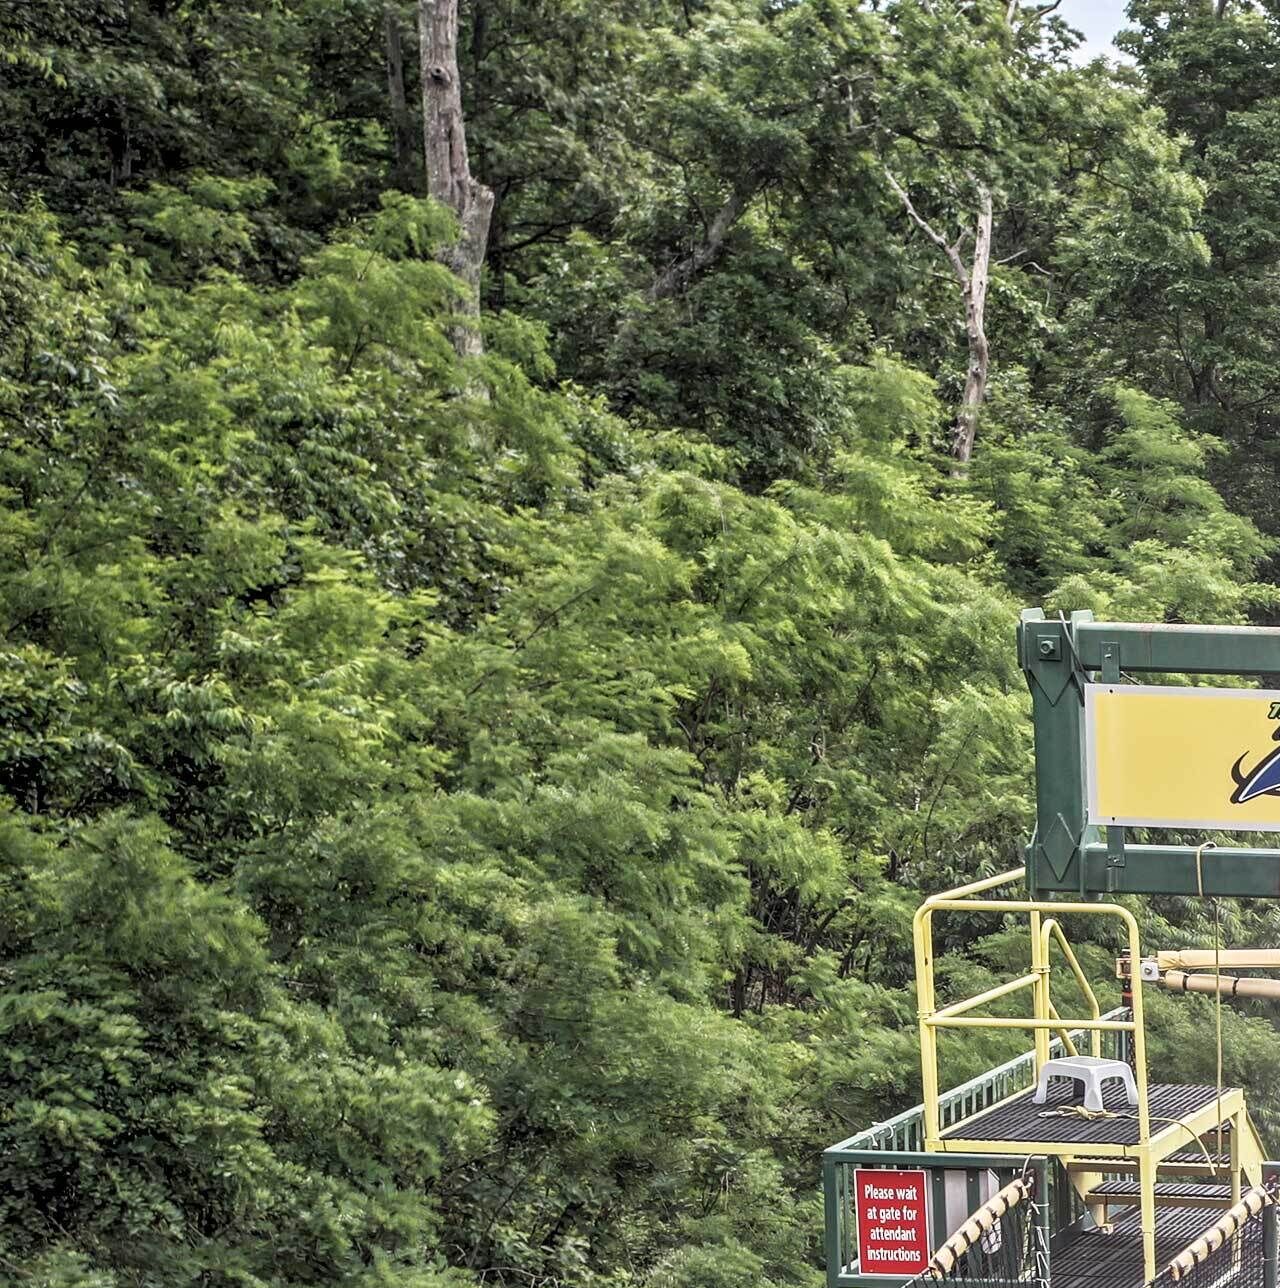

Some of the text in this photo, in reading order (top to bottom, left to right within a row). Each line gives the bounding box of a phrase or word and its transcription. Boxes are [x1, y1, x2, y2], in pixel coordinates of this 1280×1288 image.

[865, 1184, 918, 1201] Please wait
[867, 1205, 917, 1223] at gate for
[870, 1225, 916, 1242] attendant
[867, 1245, 921, 1262] instructions
